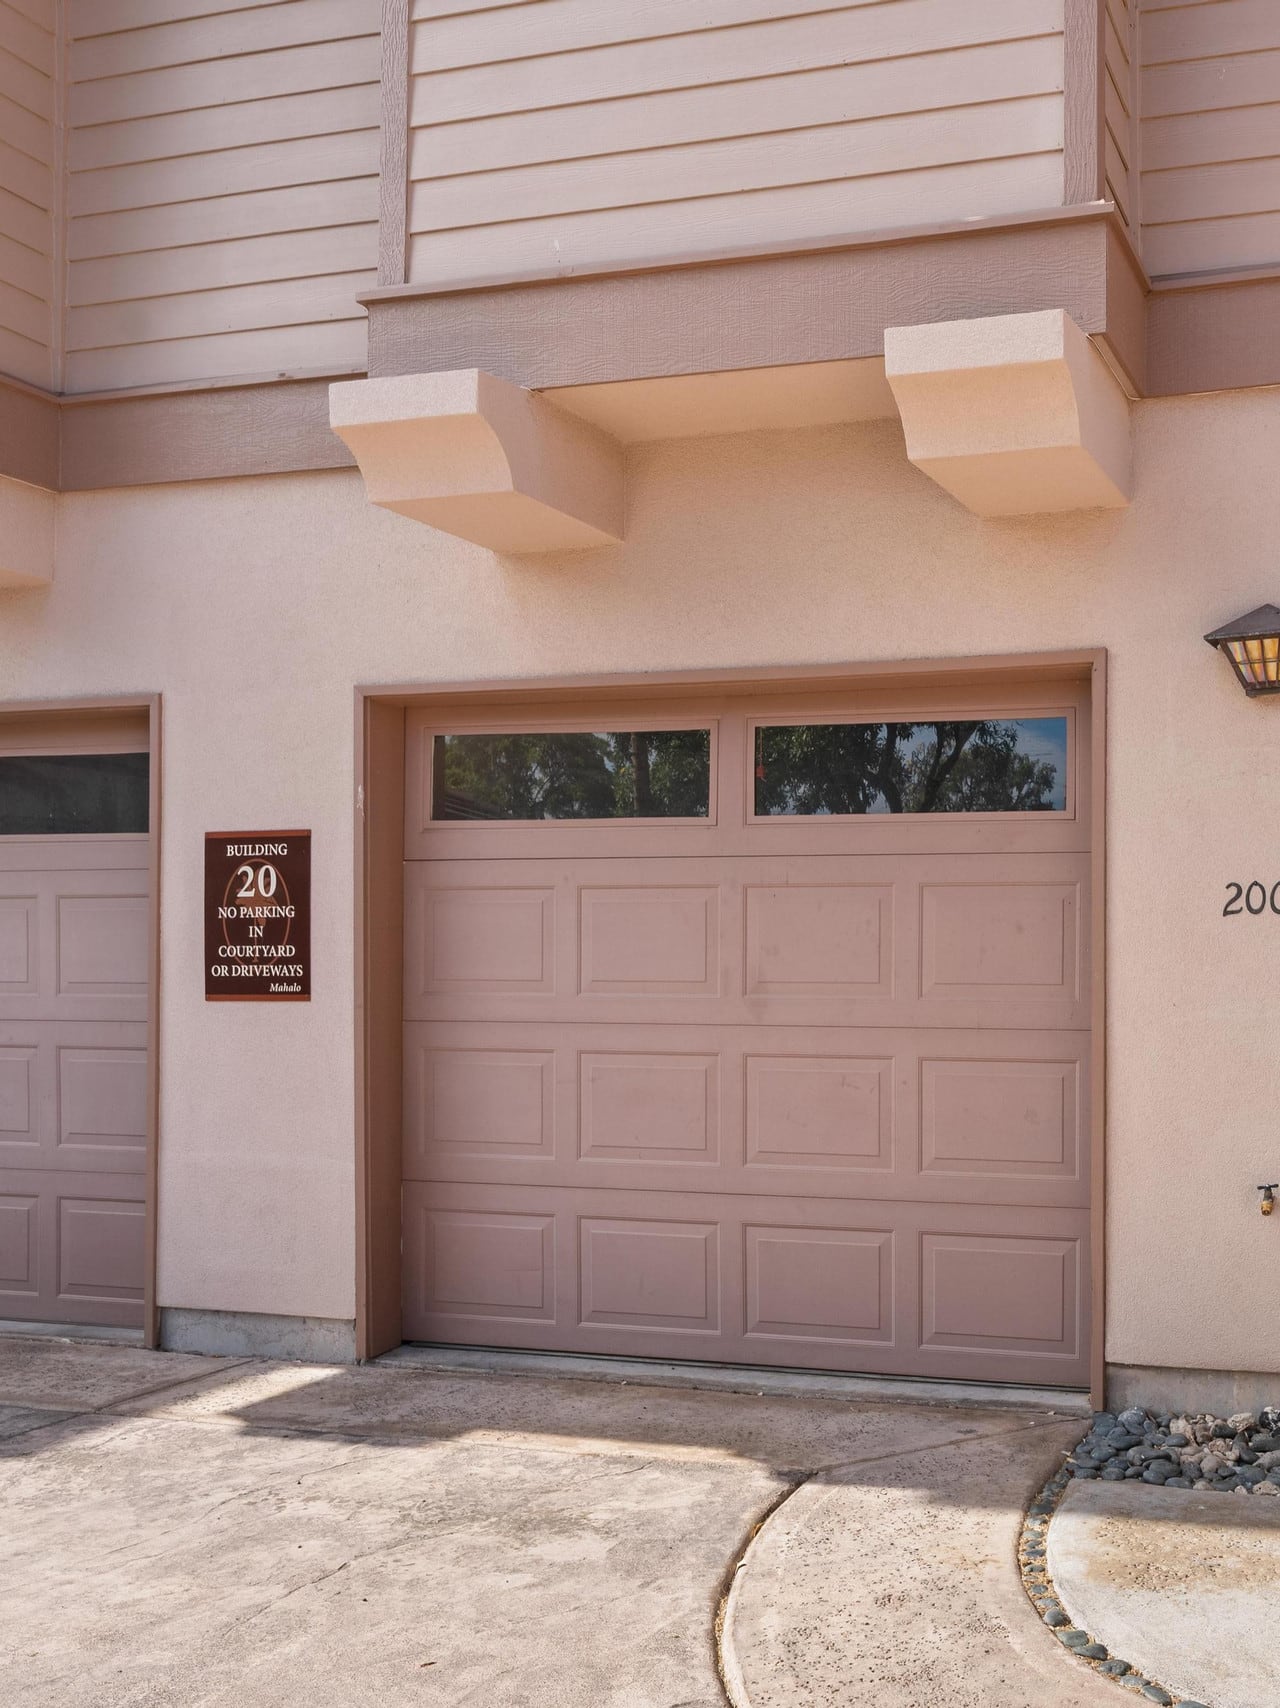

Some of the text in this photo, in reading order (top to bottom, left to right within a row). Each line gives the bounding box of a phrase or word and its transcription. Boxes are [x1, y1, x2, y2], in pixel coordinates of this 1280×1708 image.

[226, 843, 288, 857] BUILDING
[236, 865, 277, 898] 20
[218, 905, 295, 919] NO PARKING
[248, 925, 264, 938] IN
[218, 945, 296, 958] COURTYARD
[211, 964, 303, 977] OR DRIVEWAYS
[269, 982, 302, 993] Mahalo
